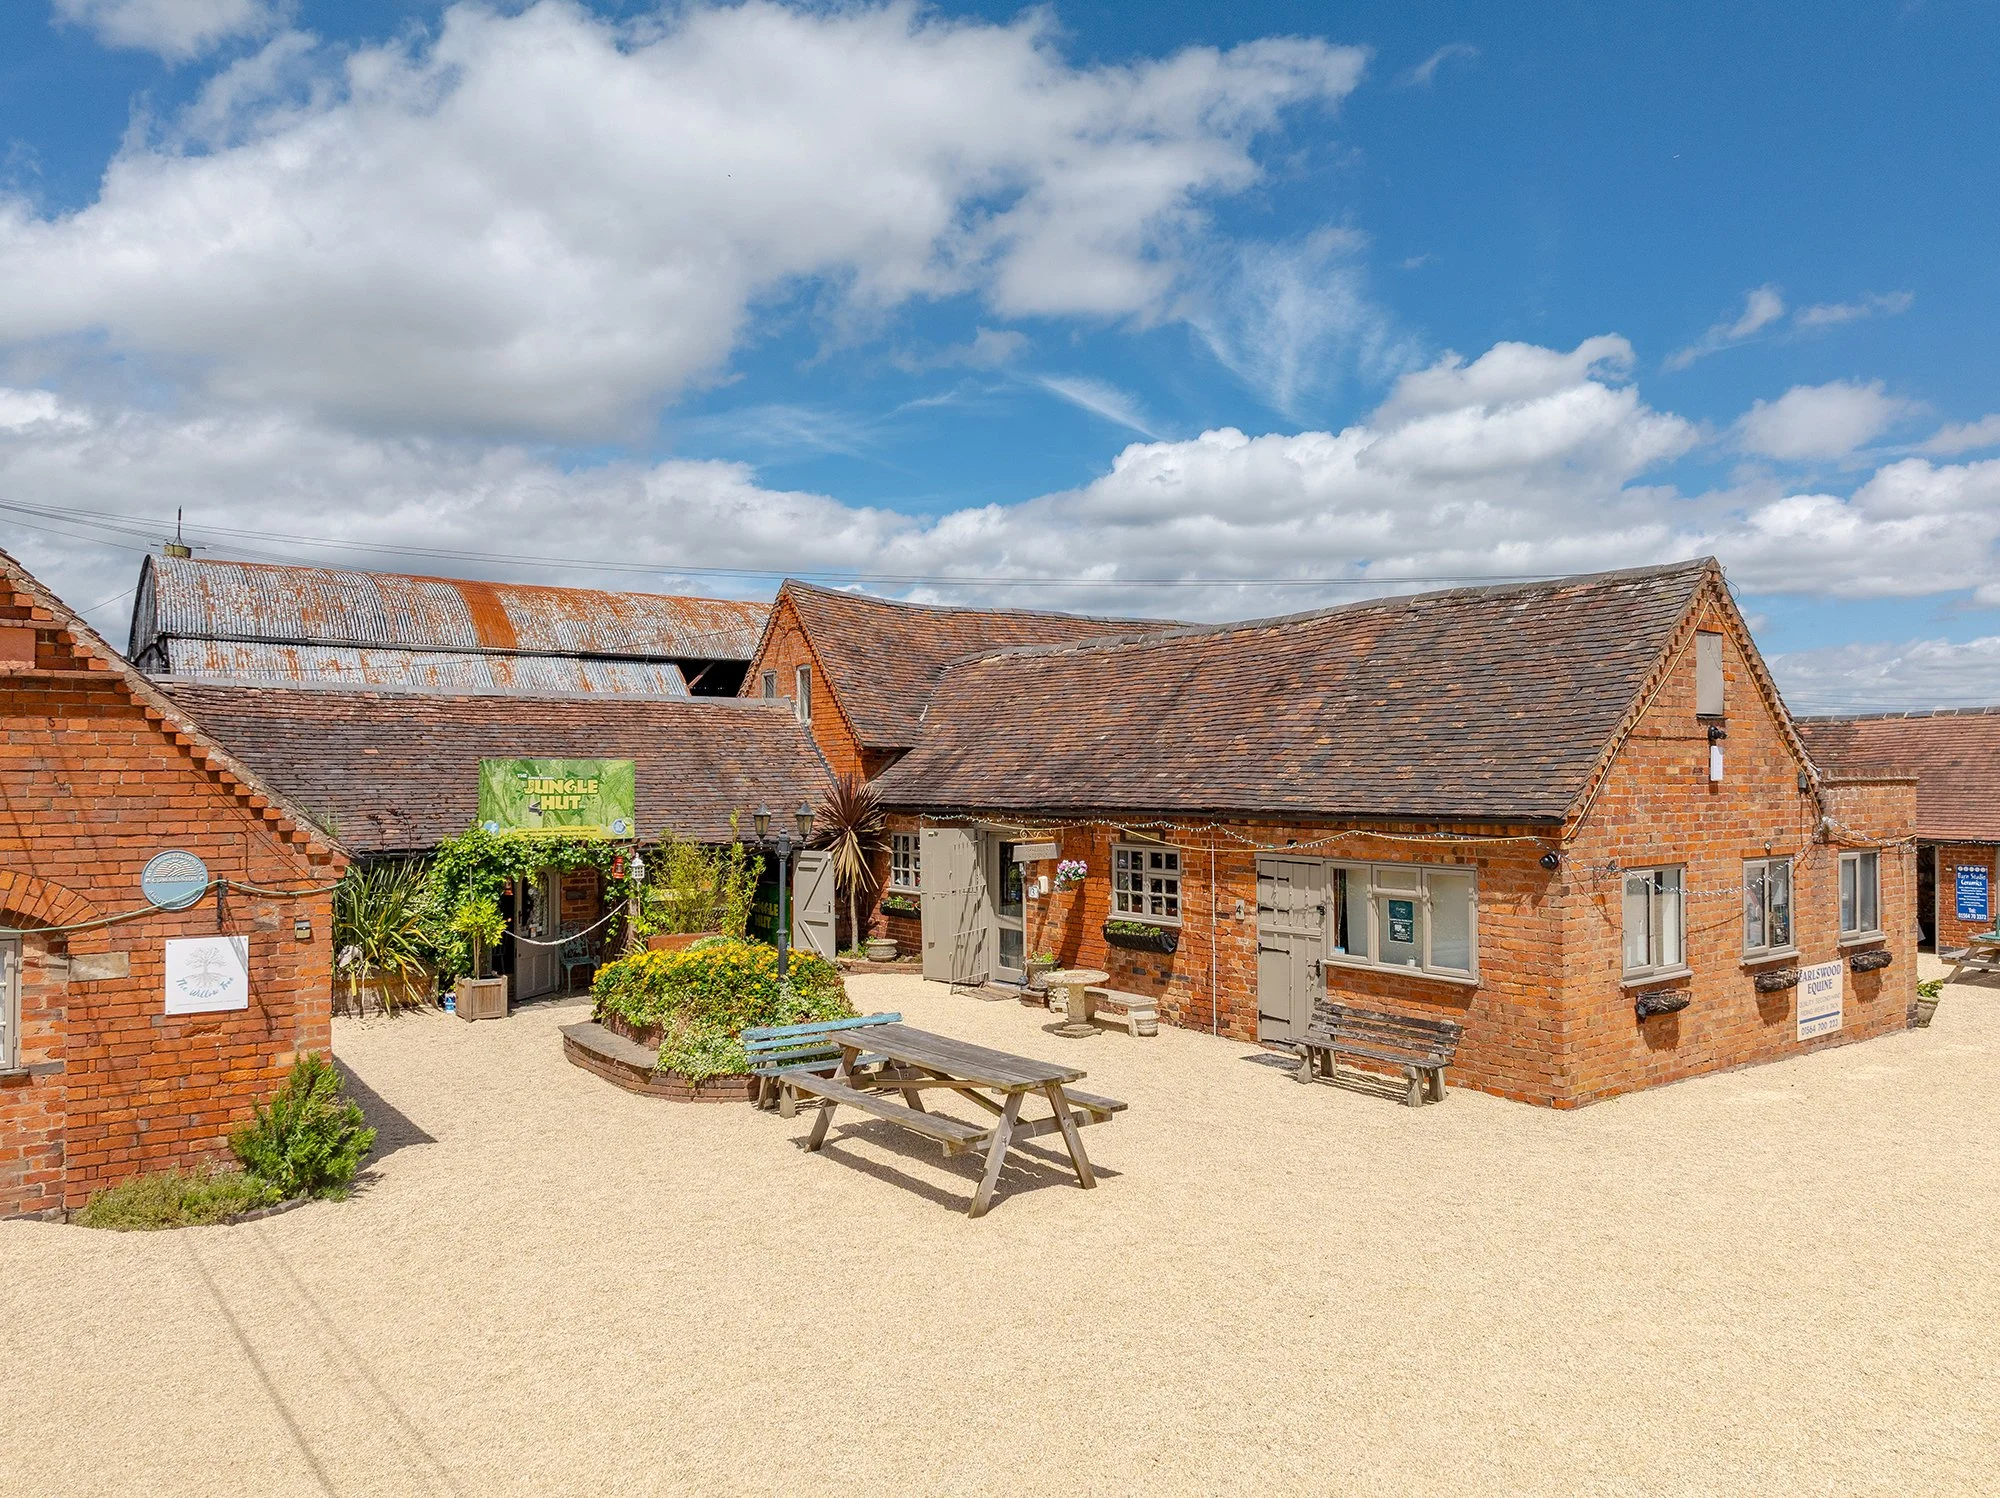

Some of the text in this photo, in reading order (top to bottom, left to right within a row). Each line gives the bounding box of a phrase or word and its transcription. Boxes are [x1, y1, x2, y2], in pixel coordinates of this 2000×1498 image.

[523, 779, 598, 795] JUNGLE
[540, 795, 582, 810] HUT
[1236, 904, 1242, 915] 4
[176, 978, 188, 991] The
[189, 989, 219, 998] Willow
[1807, 978, 1833, 995] EQUINE
[1818, 1021, 1828, 1032] 700
